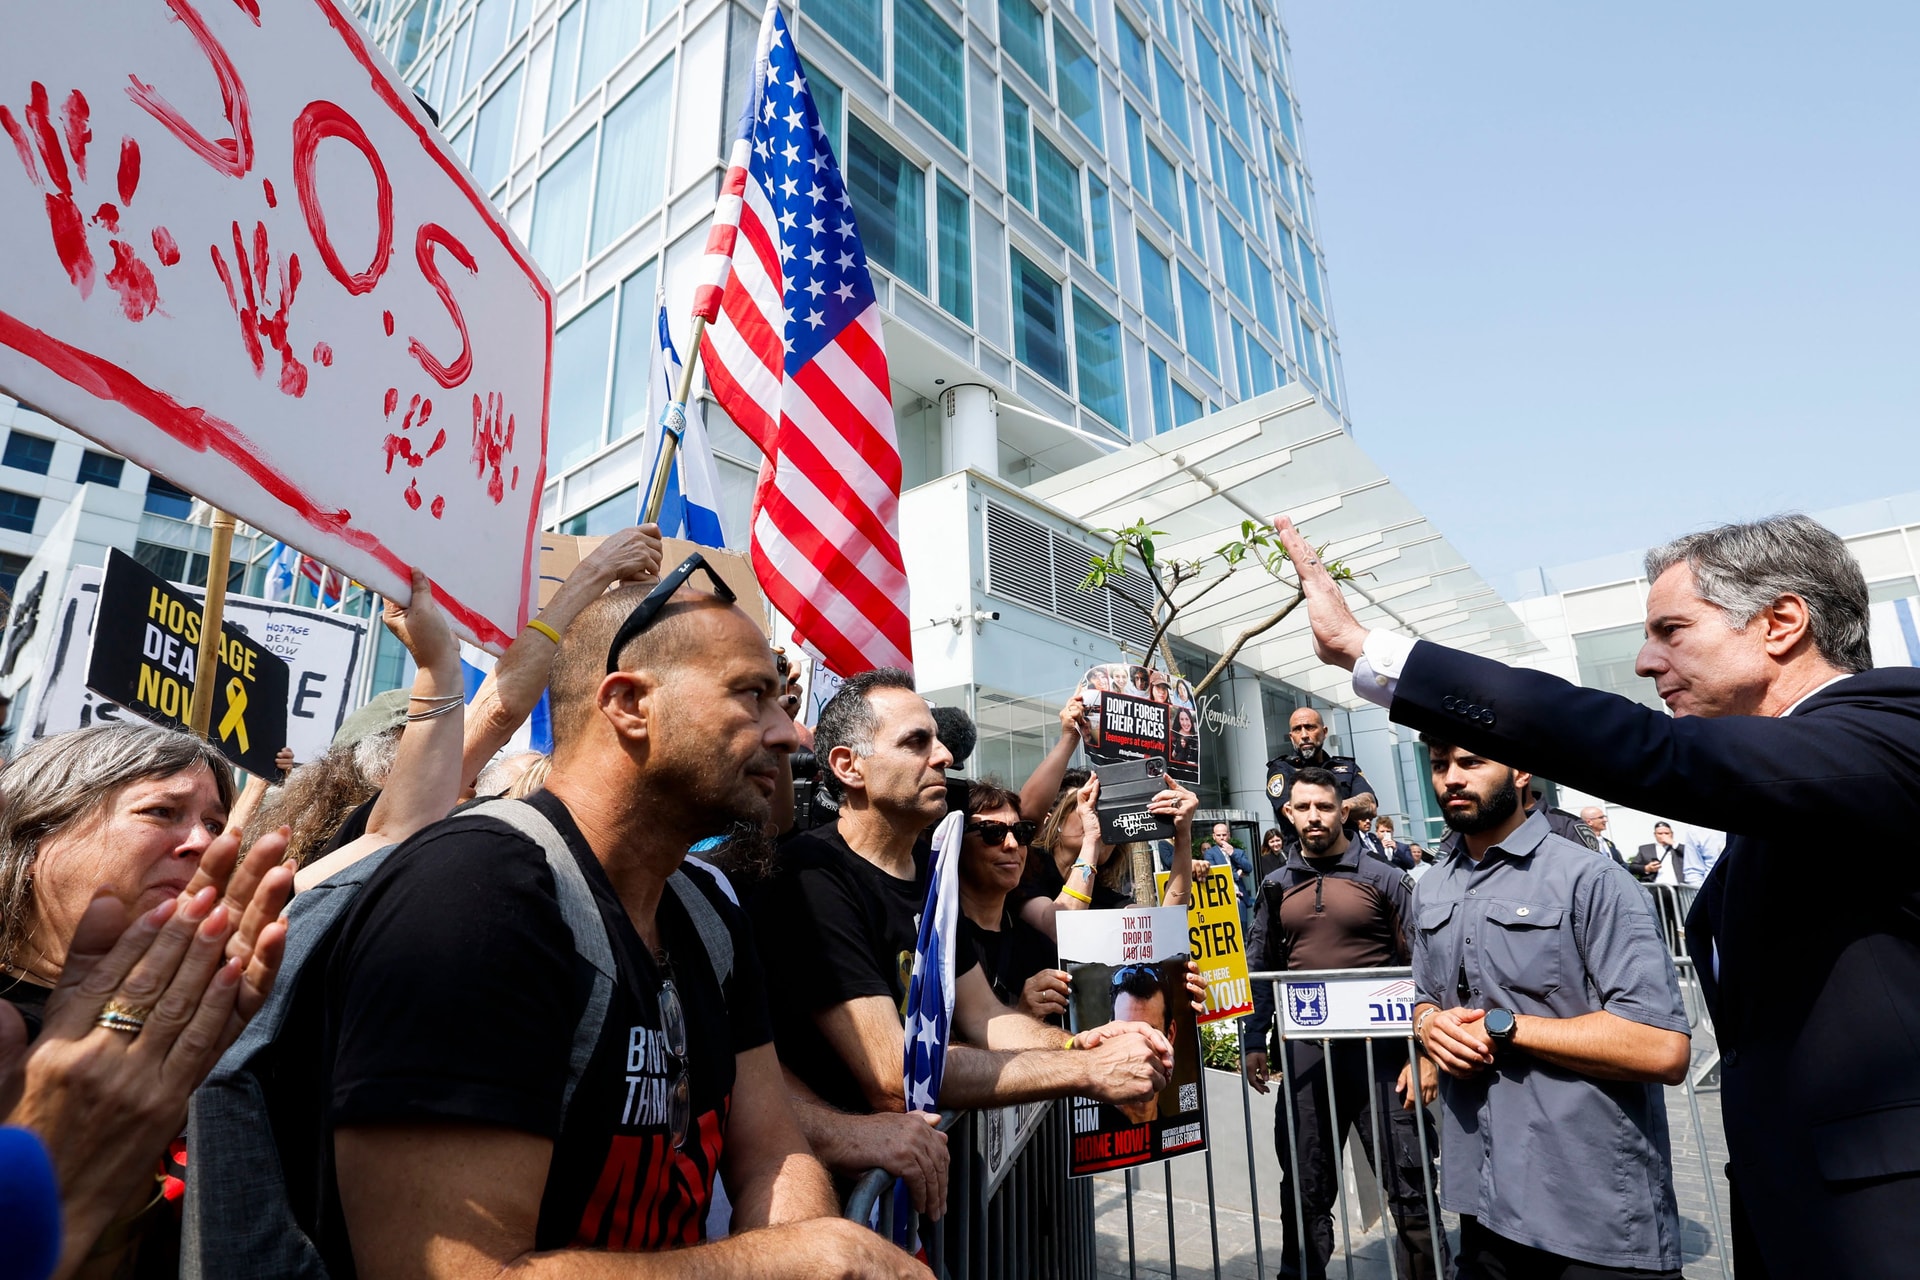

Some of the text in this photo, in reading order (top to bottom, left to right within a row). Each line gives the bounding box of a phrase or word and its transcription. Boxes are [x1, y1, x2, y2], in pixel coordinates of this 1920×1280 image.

[148, 586, 258, 682] HOSAGE
[266, 622, 310, 636] HOSTAGE
[264, 643, 298, 655] NOW
[266, 634, 302, 645] DEAL
[143, 622, 195, 683] DEA
[814, 661, 847, 688] Pre
[1106, 696, 1165, 723] DON'T FORGET
[1106, 712, 1165, 740] THEIR FACES
[1105, 731, 1165, 753] Teenagers at captivity
[820, 800, 838, 812] SON
[1122, 916, 1136, 930] אור
[1196, 911, 1205, 924] To
[1122, 930, 1152, 945] DROR OR
[1140, 944, 1153, 960] (49)
[1213, 966, 1230, 981] HERE
[1208, 977, 1249, 1013] YOU!
[1074, 1106, 1100, 1134] HIM
[1075, 1122, 1151, 1163] HOME NOW!
